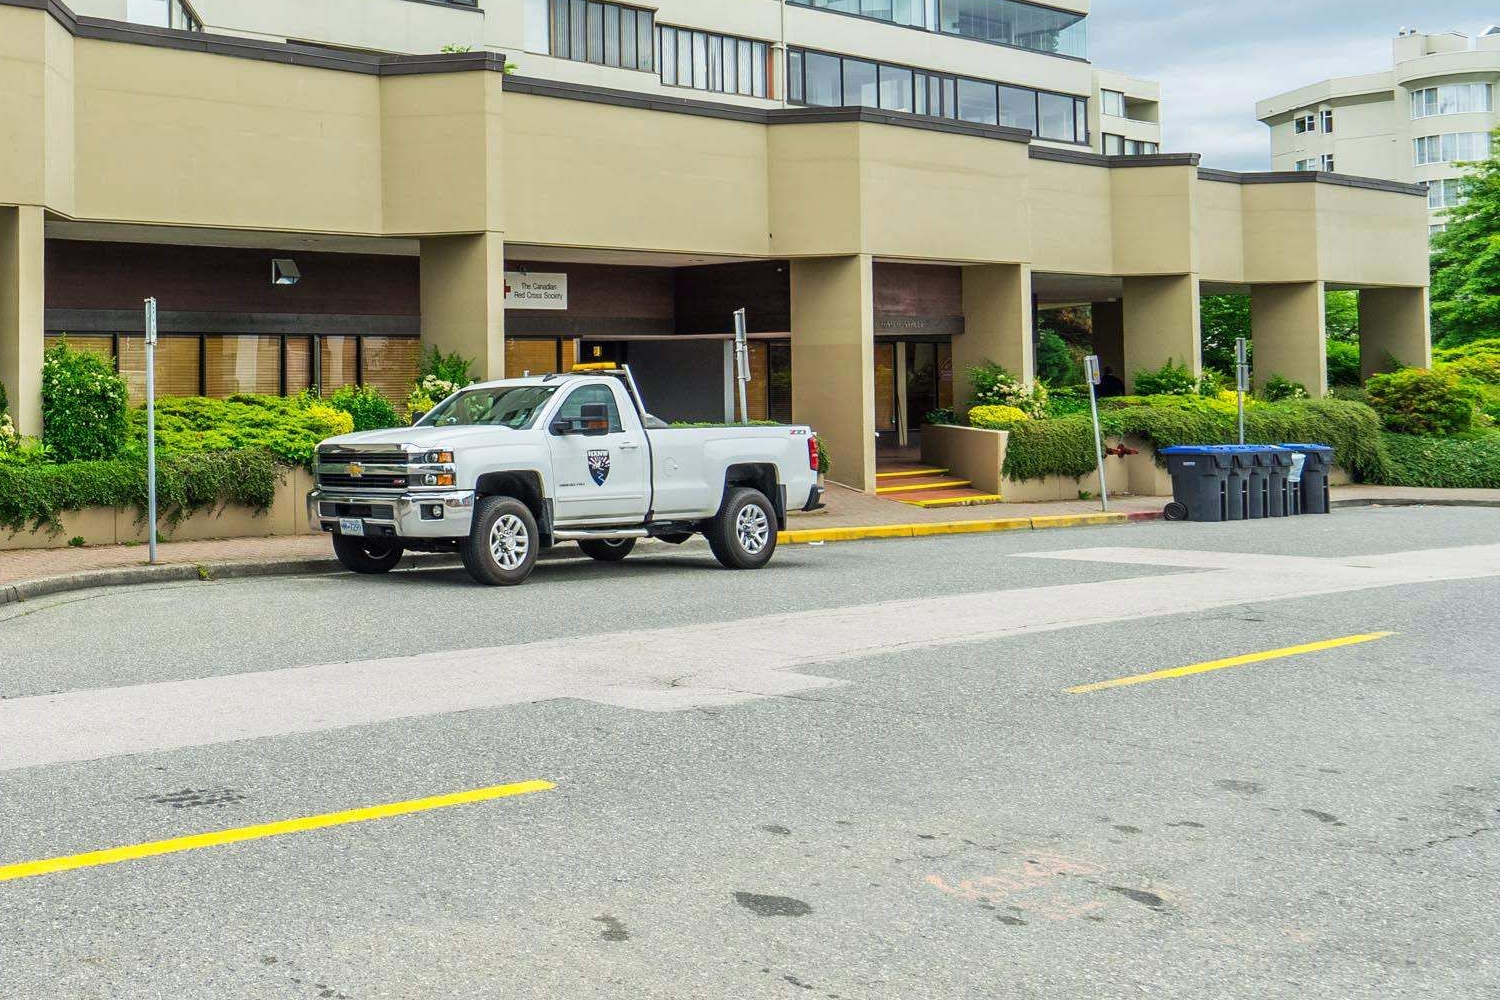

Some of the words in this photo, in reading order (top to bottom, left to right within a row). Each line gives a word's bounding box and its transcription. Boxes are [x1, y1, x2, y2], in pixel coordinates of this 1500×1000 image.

[521, 282, 532, 290] The
[533, 282, 557, 290] Canadian
[514, 291, 526, 299] Red
[527, 291, 542, 299] Cross
[544, 291, 563, 300] Society
